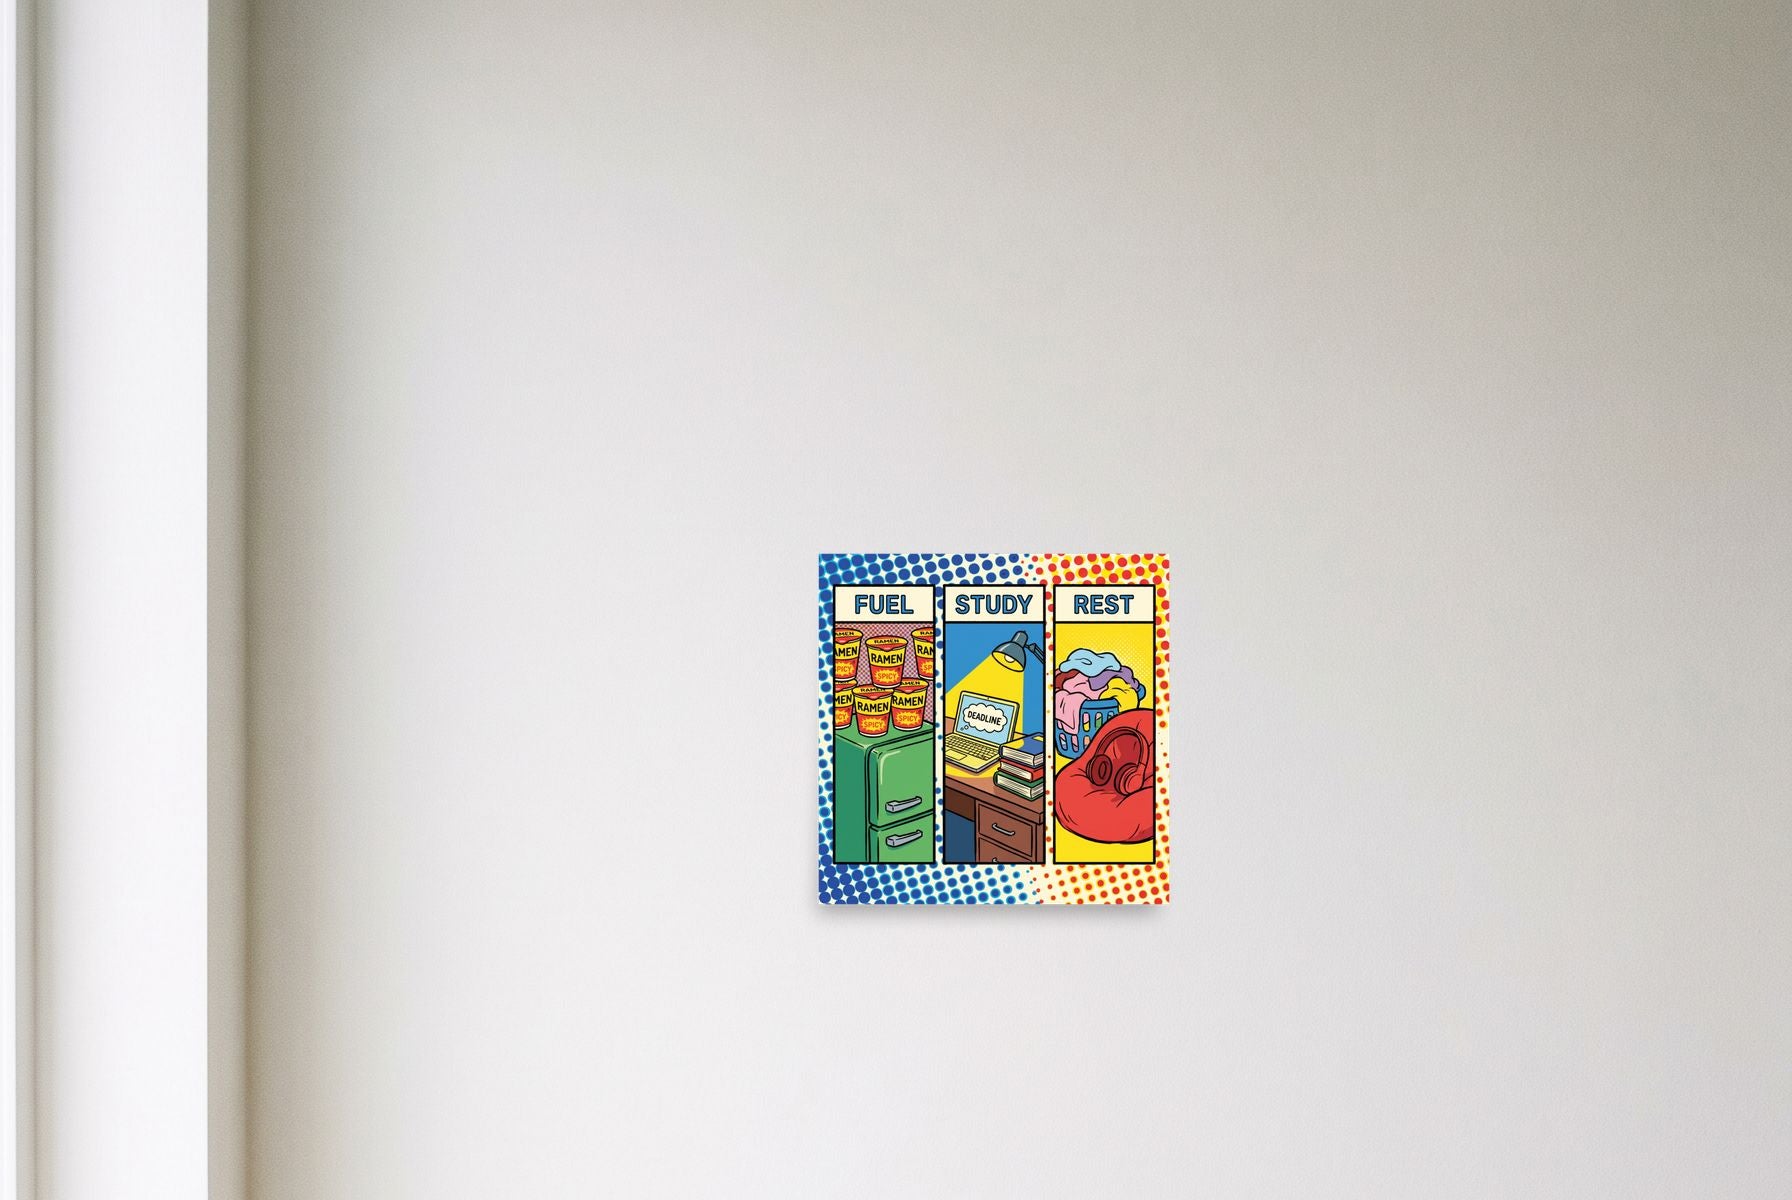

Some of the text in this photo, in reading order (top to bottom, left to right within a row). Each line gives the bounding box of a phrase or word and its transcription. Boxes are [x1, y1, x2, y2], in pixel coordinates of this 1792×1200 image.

[854, 594, 914, 615] FUEL
[955, 594, 1033, 615] STUDY
[1074, 594, 1134, 615] REST
[871, 653, 903, 664] RAMEN
[857, 701, 889, 713] RAMEN
[892, 695, 924, 705] RAMEN
[898, 714, 918, 722] SPICY
[967, 710, 1002, 726] DEADLINE
